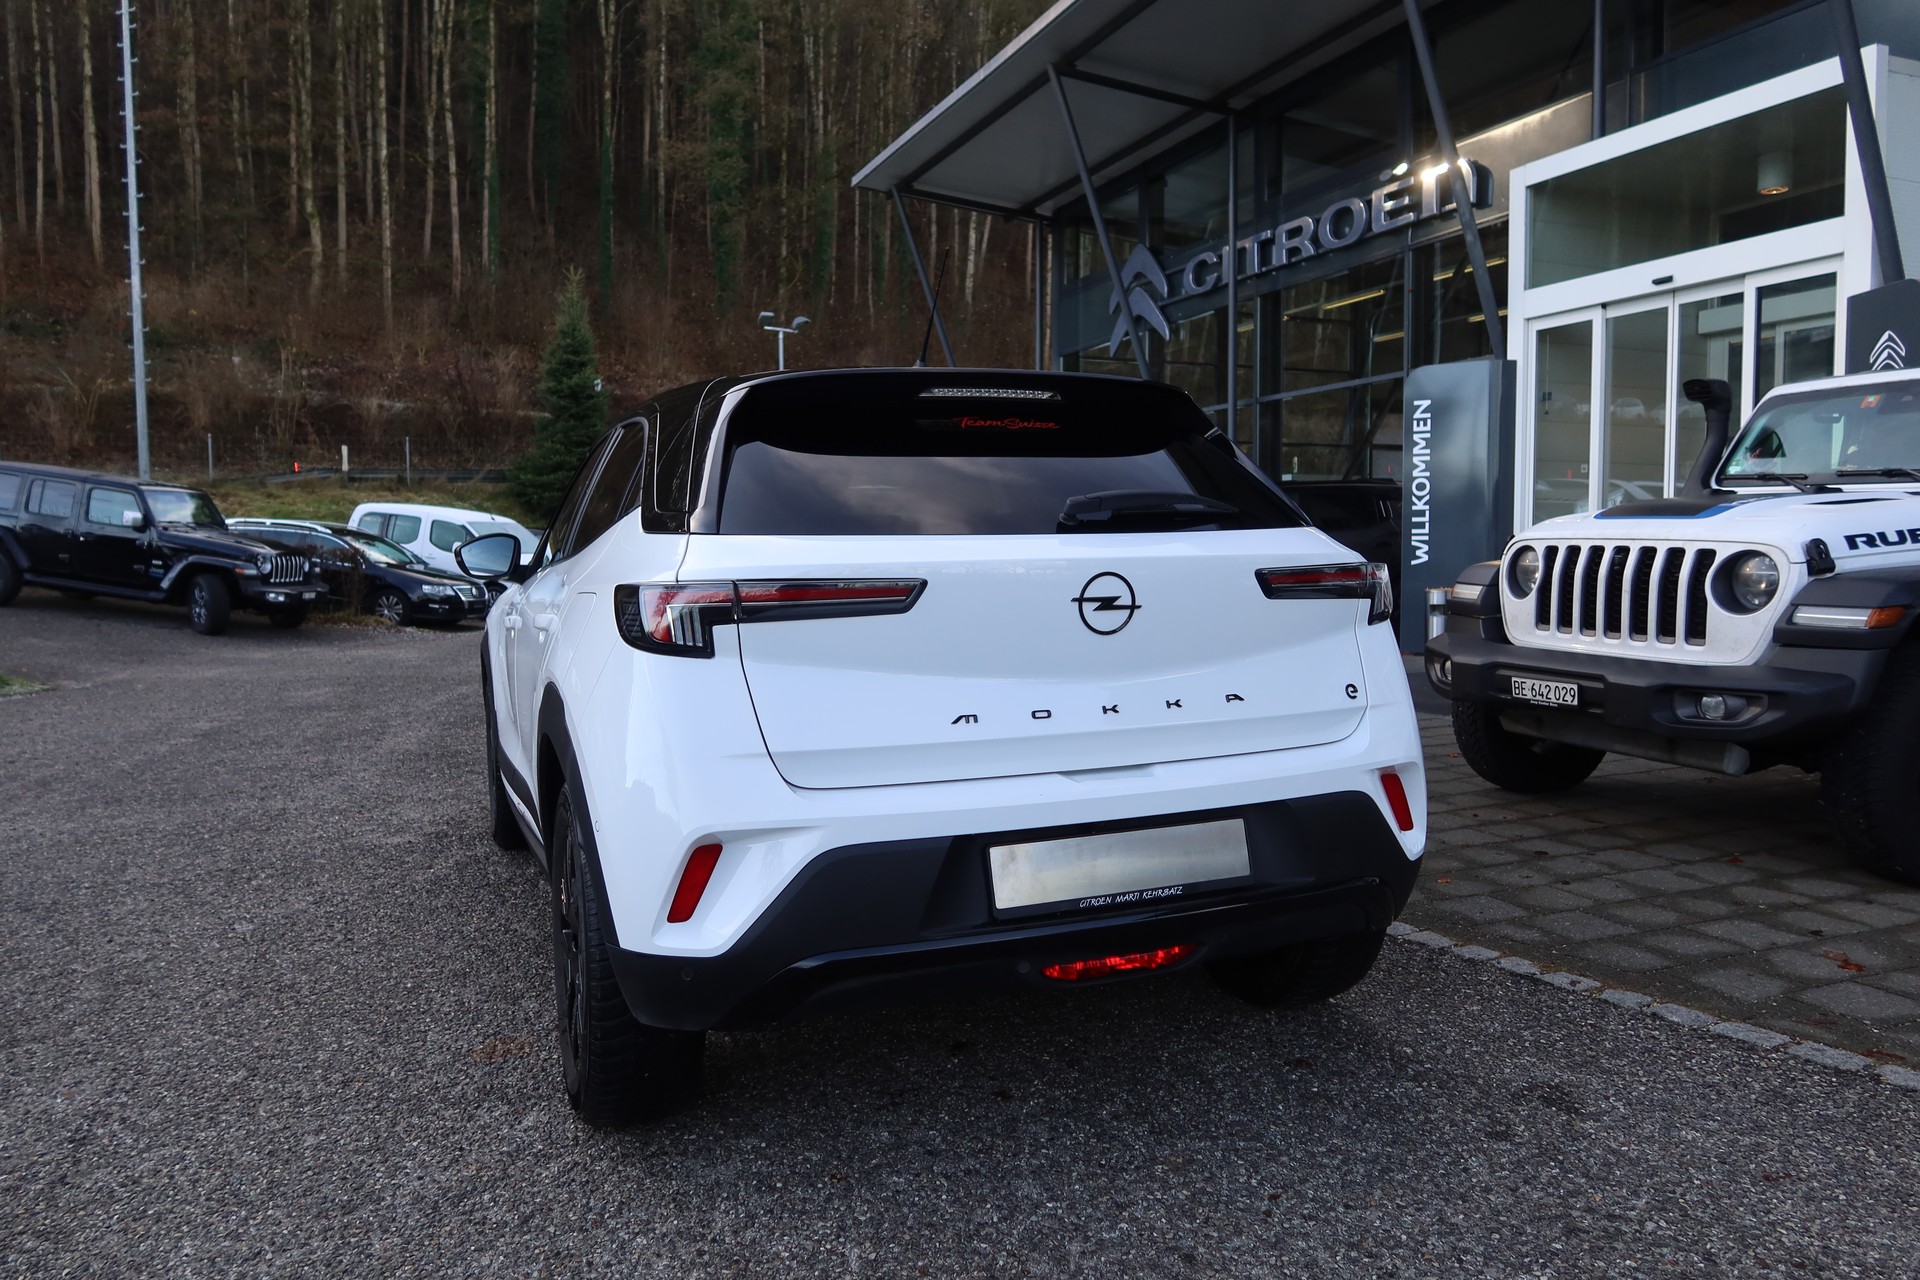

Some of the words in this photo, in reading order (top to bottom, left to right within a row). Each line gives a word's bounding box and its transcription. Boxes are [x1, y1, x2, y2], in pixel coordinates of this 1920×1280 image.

[1183, 158, 1478, 294] CITROËN
[1411, 399, 1431, 565] WILLKOMMEN
[951, 693, 1245, 725] MOKKA
